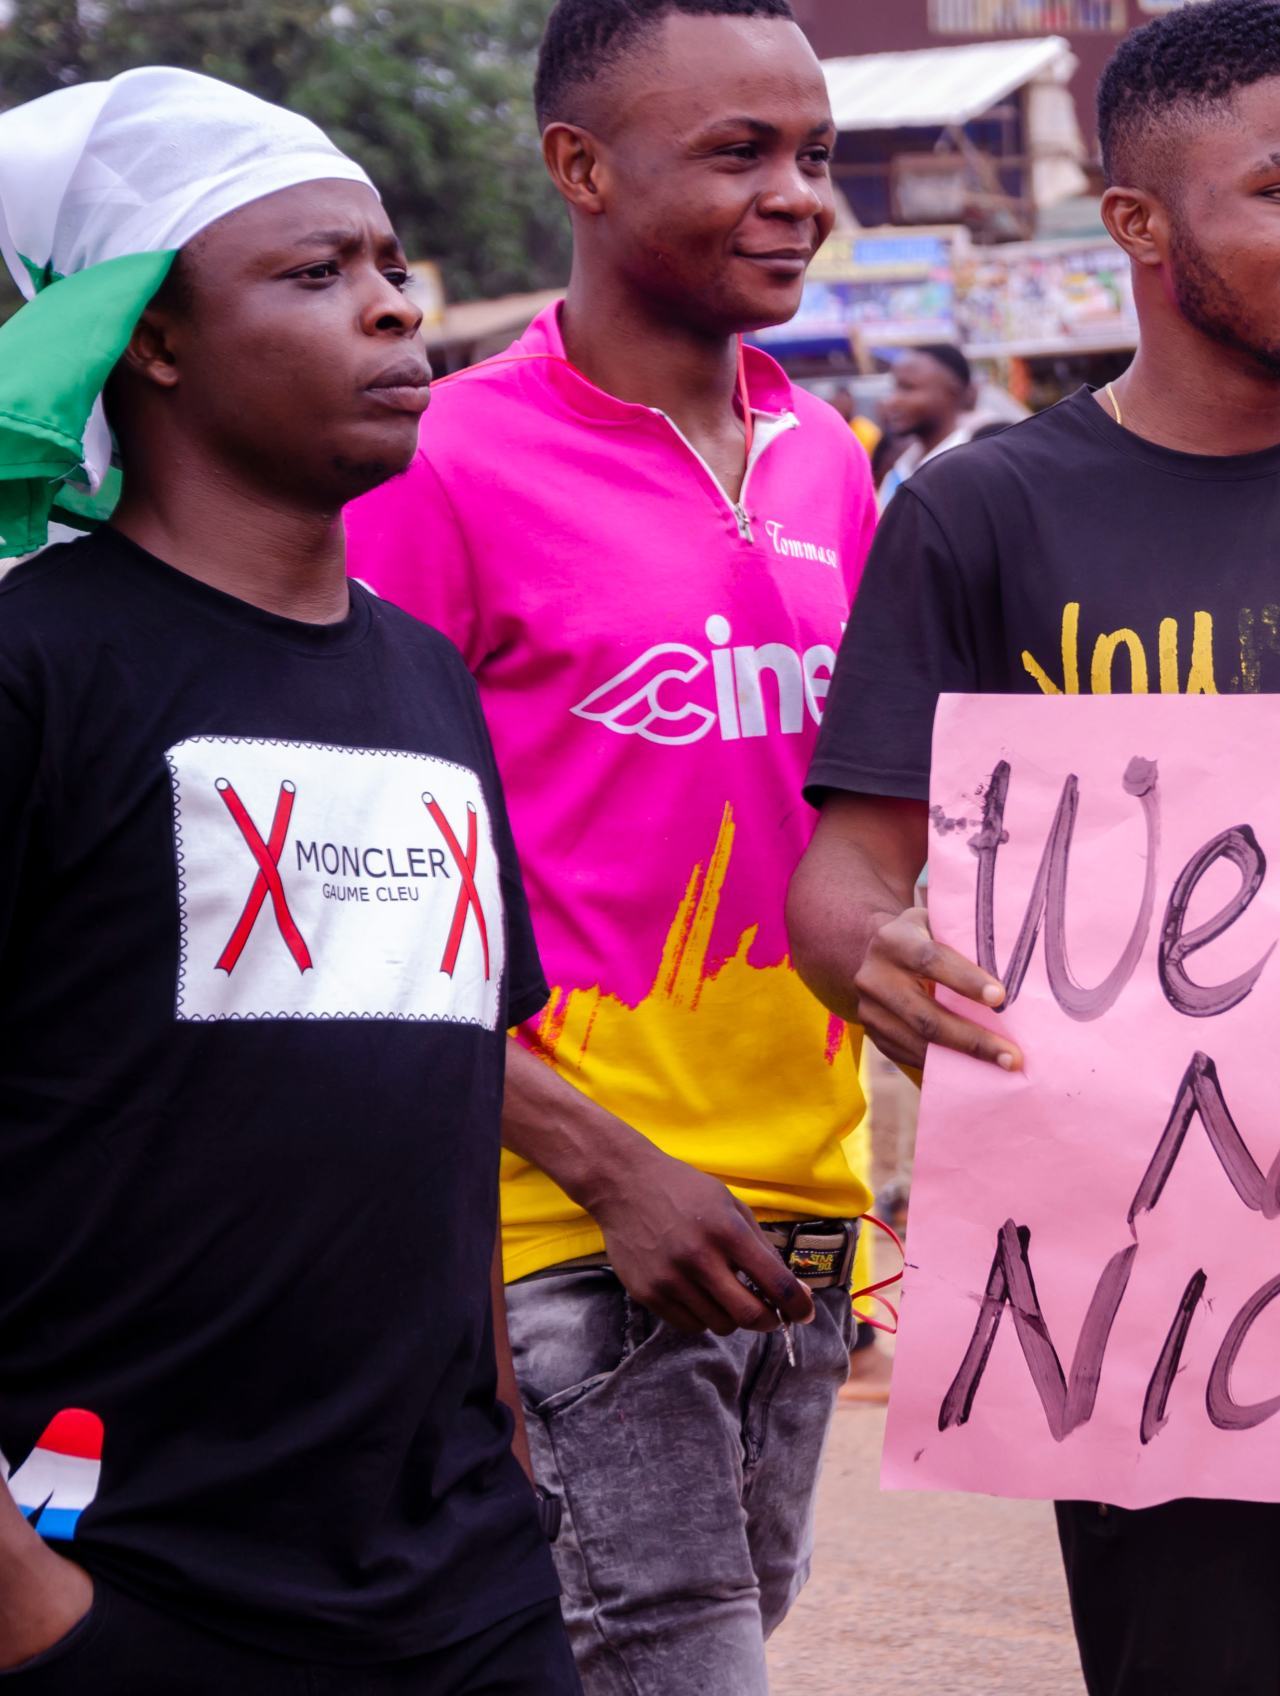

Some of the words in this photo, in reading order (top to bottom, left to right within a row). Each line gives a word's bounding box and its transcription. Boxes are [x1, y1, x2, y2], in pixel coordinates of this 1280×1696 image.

[569, 613, 840, 746] Cine
[294, 839, 451, 881] MONCLER
[321, 882, 370, 903] GAUME
[375, 885, 420, 902] CLEU
[974, 755, 1278, 1022] We
